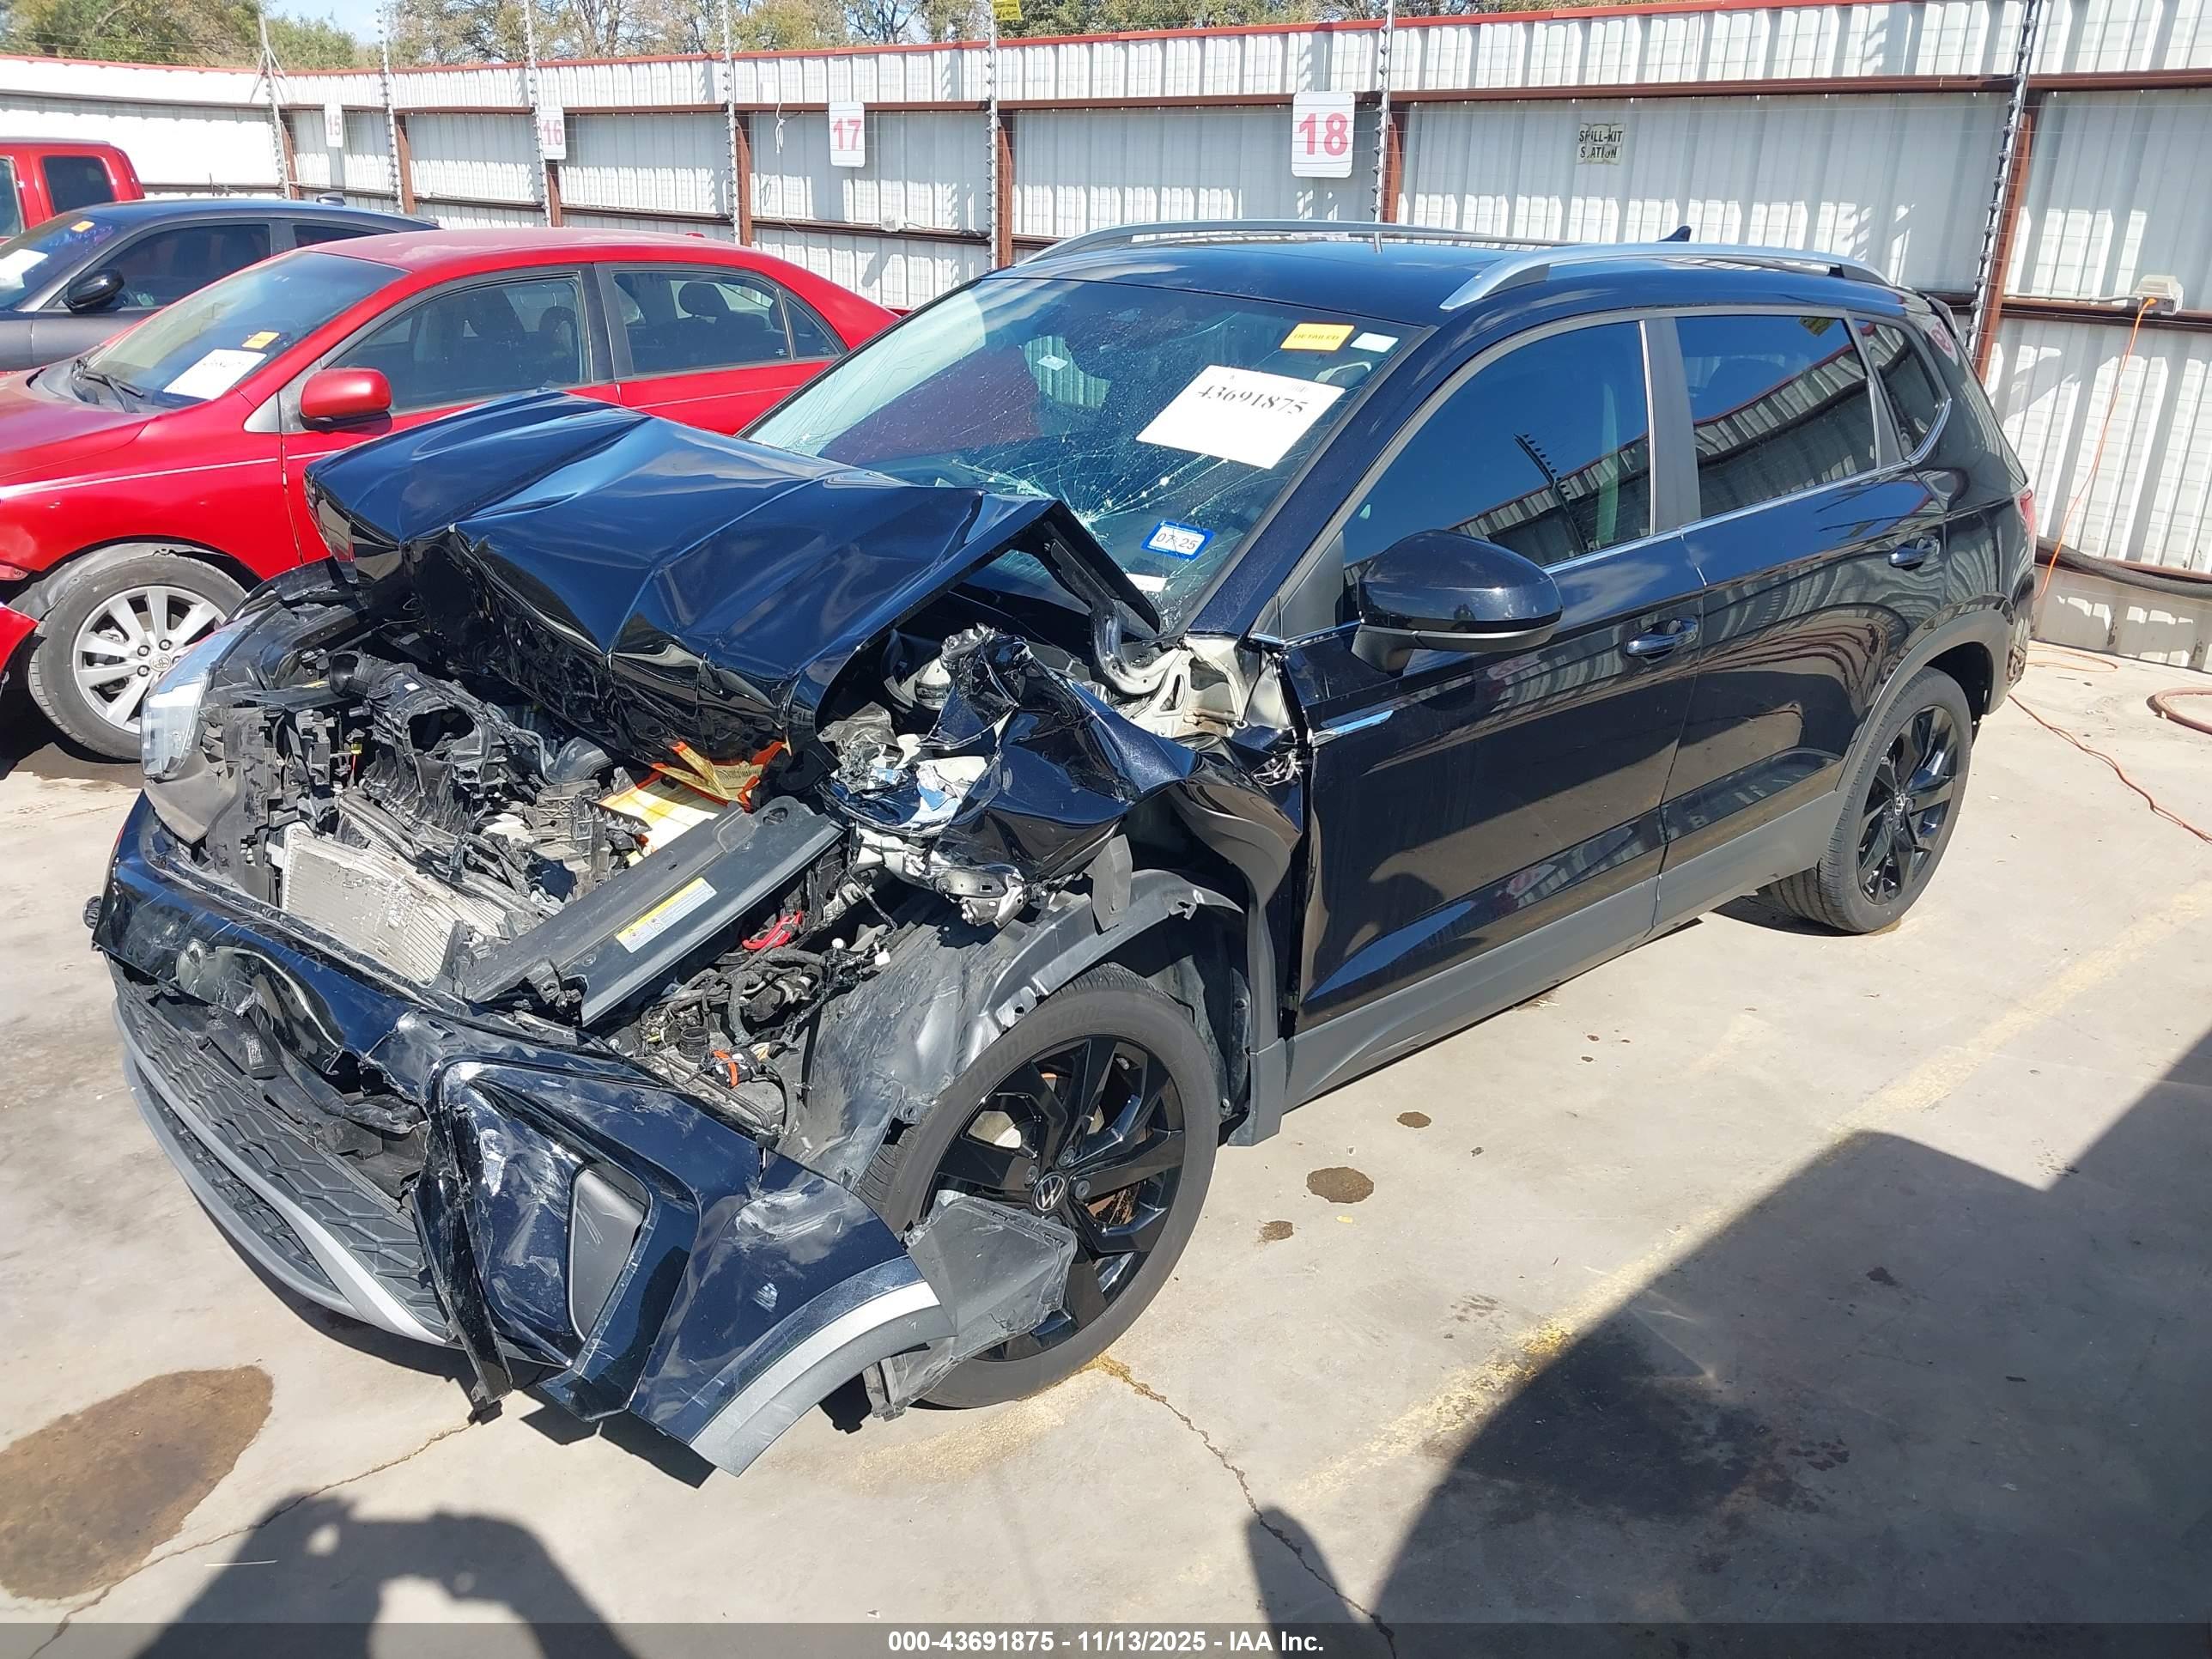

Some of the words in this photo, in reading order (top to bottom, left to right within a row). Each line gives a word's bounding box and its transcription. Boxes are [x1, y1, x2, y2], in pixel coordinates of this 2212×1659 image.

[327, 114, 341, 136] 15
[544, 119, 563, 146] 16
[833, 117, 862, 151] 17
[1298, 112, 1348, 156] 18
[1580, 146, 1618, 159] SATION
[1197, 385, 1309, 415] 43691875
